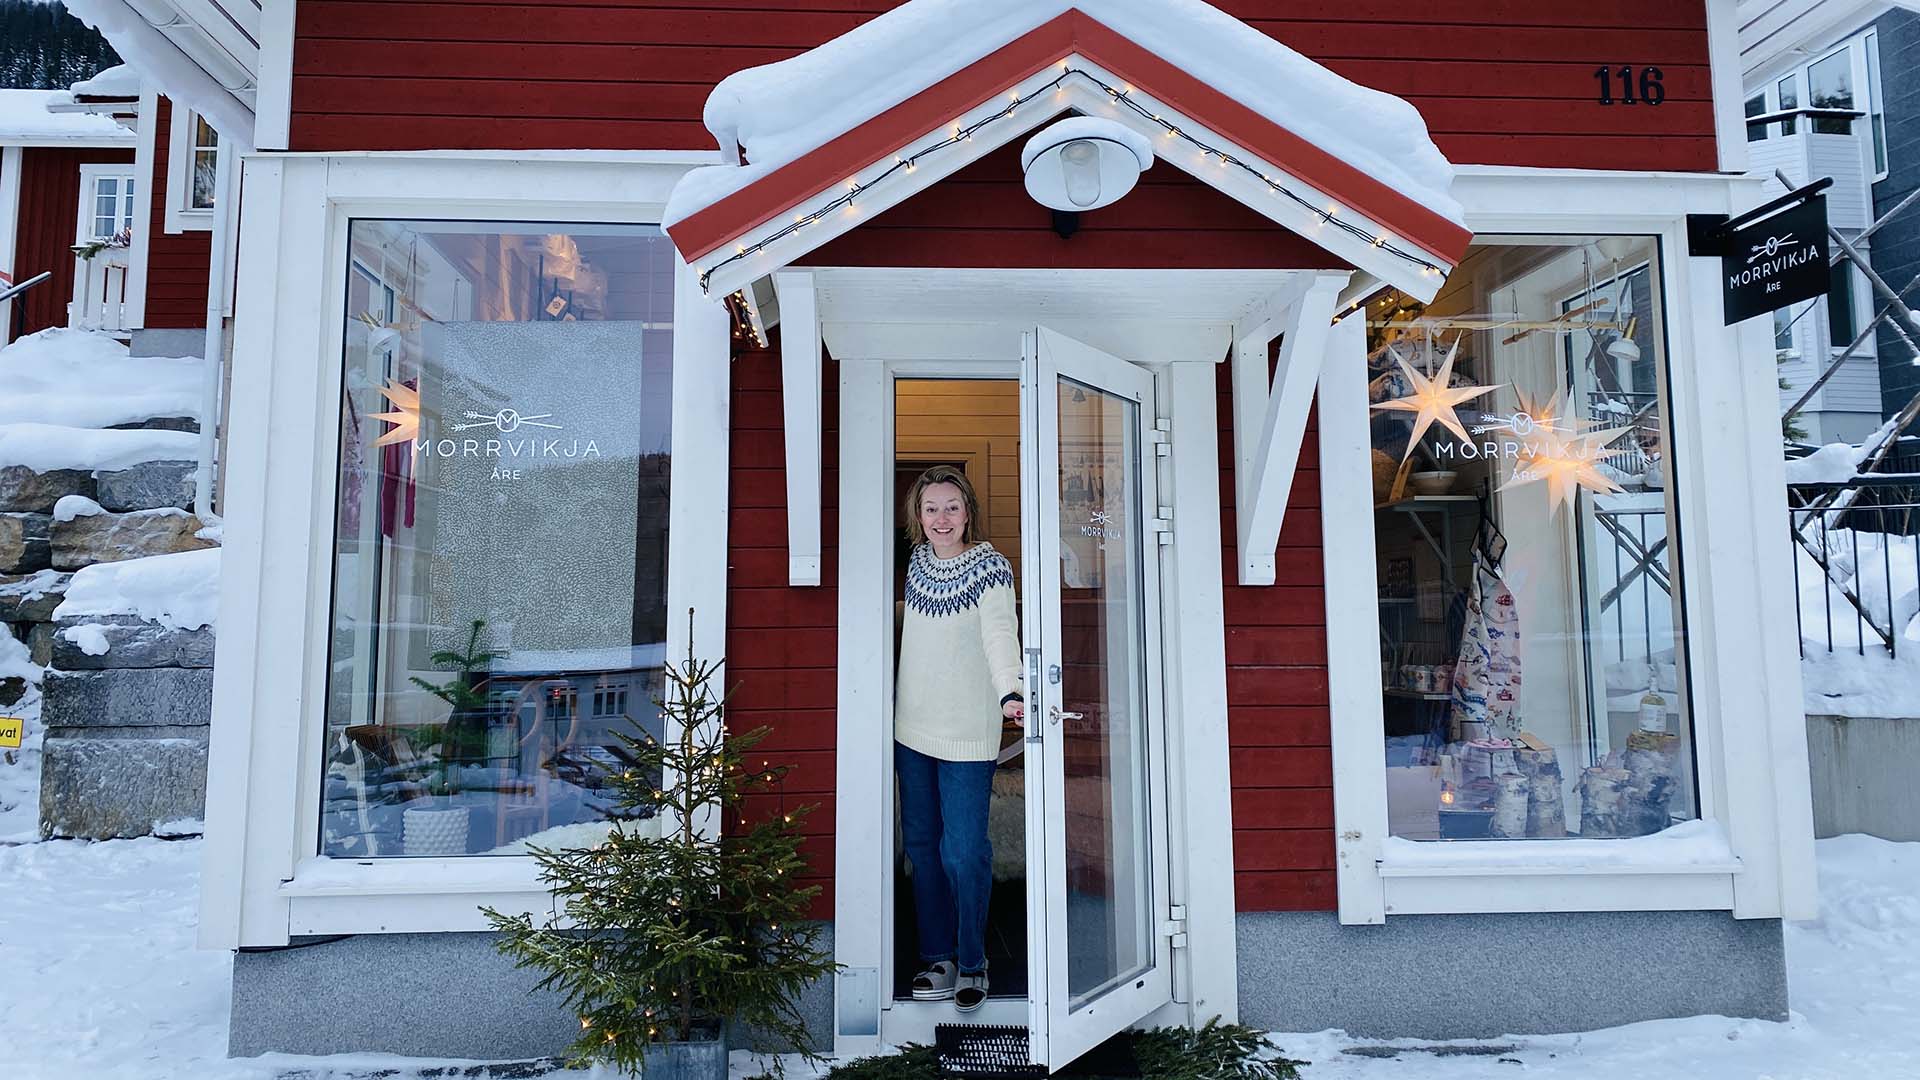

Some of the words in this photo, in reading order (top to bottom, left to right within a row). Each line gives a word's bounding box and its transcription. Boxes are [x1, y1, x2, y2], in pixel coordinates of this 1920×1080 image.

[1593, 65, 1665, 106] 116
[1730, 244, 1819, 289] MORRVIKJA
[1766, 281, 1782, 293] ÅRE
[411, 439, 601, 457] MORRVIKJA
[1435, 441, 1611, 459] MORRVIKJA
[490, 467, 521, 480] ÅRE
[1511, 468, 1539, 481] ÅRE
